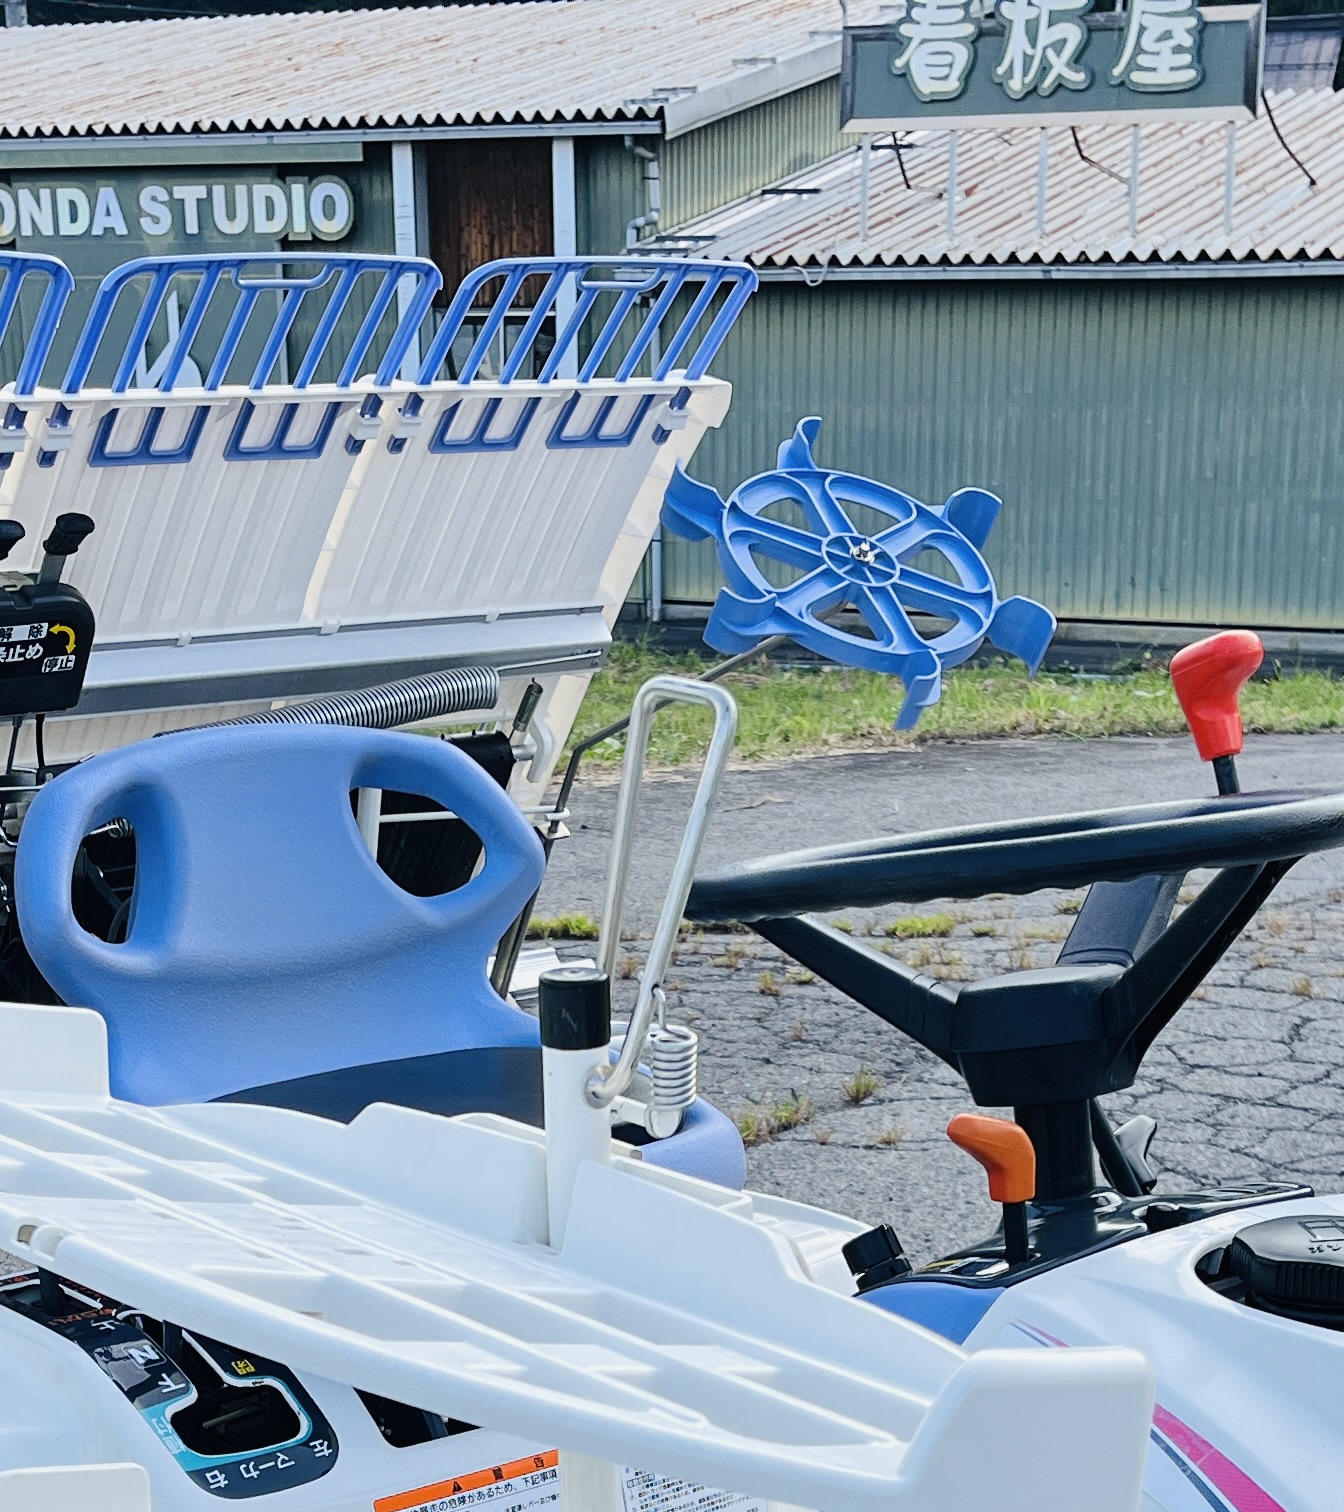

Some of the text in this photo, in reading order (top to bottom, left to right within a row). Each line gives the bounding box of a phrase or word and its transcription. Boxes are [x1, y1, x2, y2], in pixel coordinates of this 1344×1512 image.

[892, 0, 1200, 97] 看板屋
[138, 181, 352, 236] STUDIO
[45, 655, 74, 671] 停止
[157, 1372, 186, 1394] 下
[309, 1438, 333, 1458] 左
[239, 1452, 297, 1479] マーカ
[204, 1469, 229, 1490] 右
